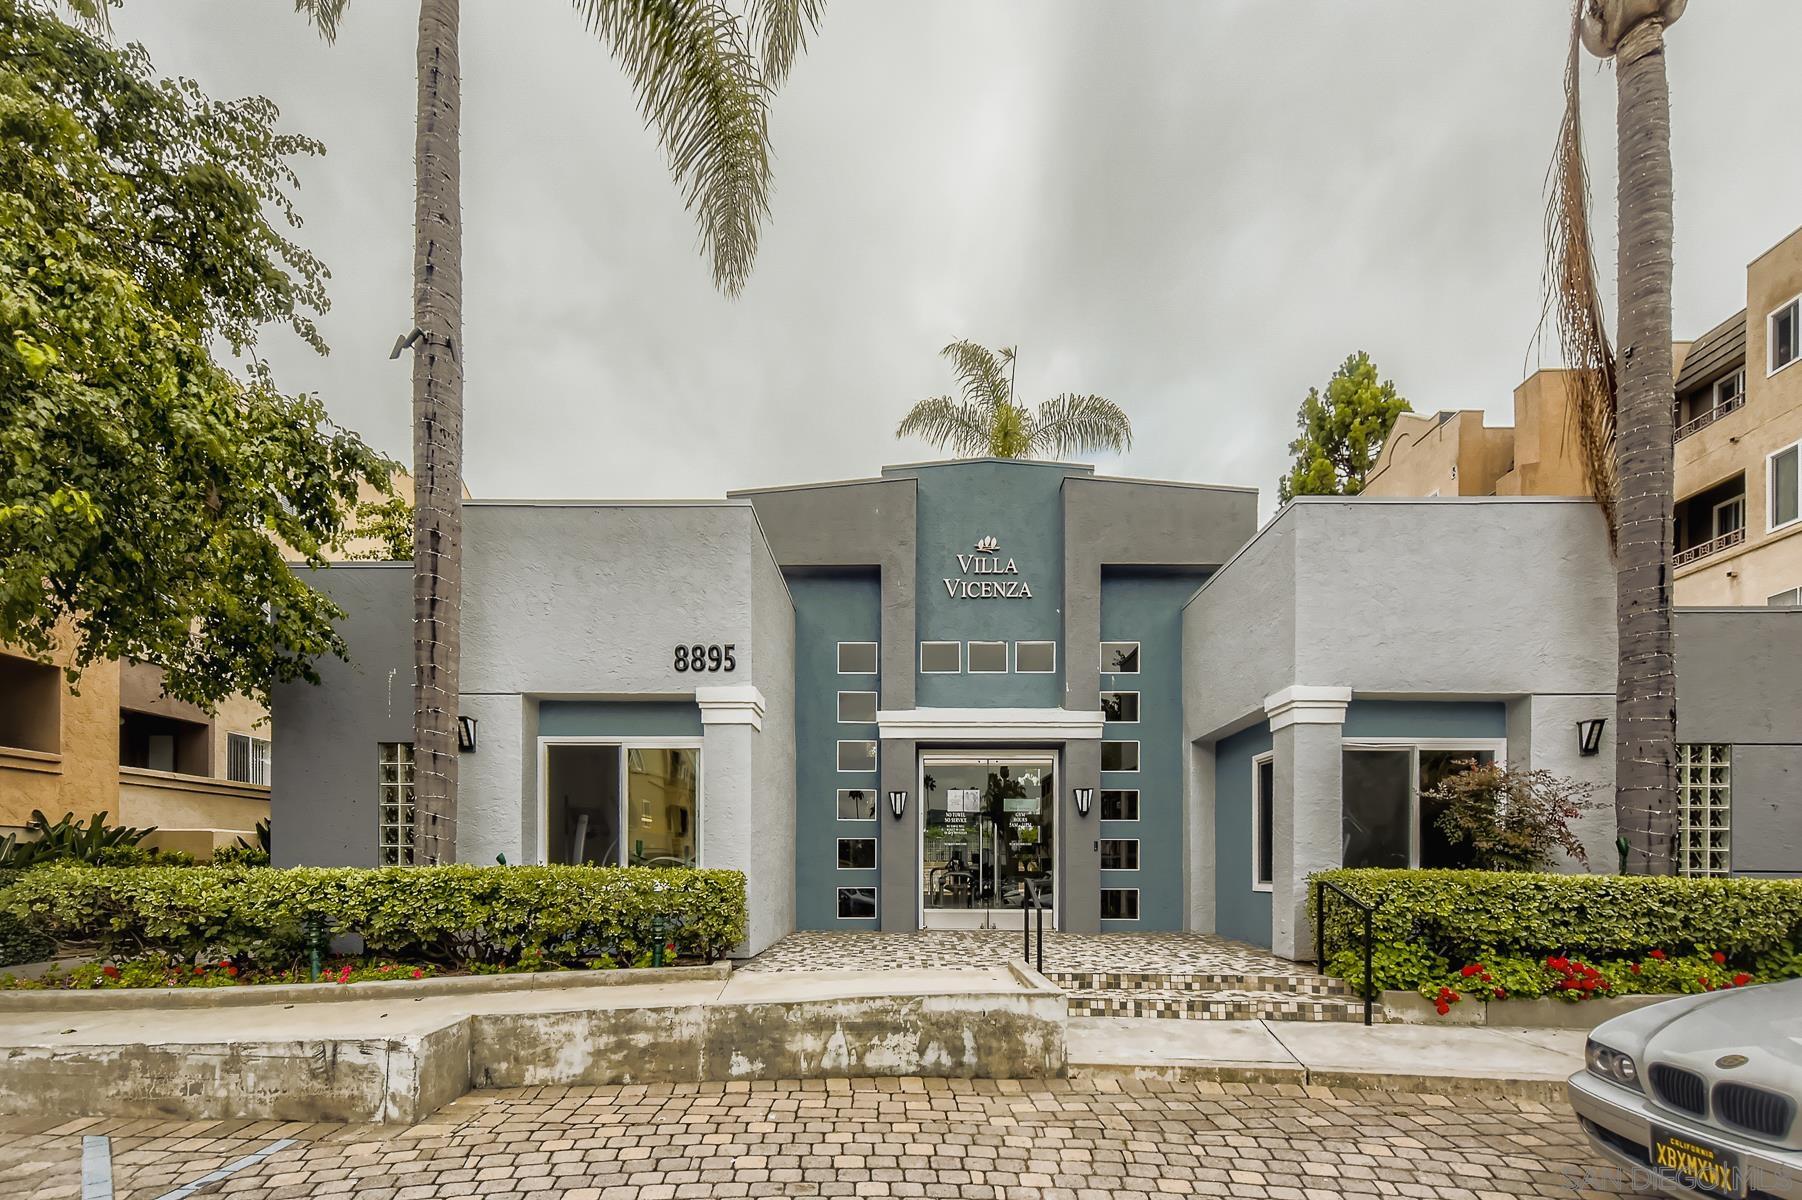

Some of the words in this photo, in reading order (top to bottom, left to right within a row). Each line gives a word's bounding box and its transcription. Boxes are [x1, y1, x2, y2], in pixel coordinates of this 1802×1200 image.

[956, 554, 1018, 574] VILLA
[943, 578, 1033, 598] VICENZA
[674, 644, 736, 672] 8895
[1670, 1137, 1714, 1159] CALIFORNIA
